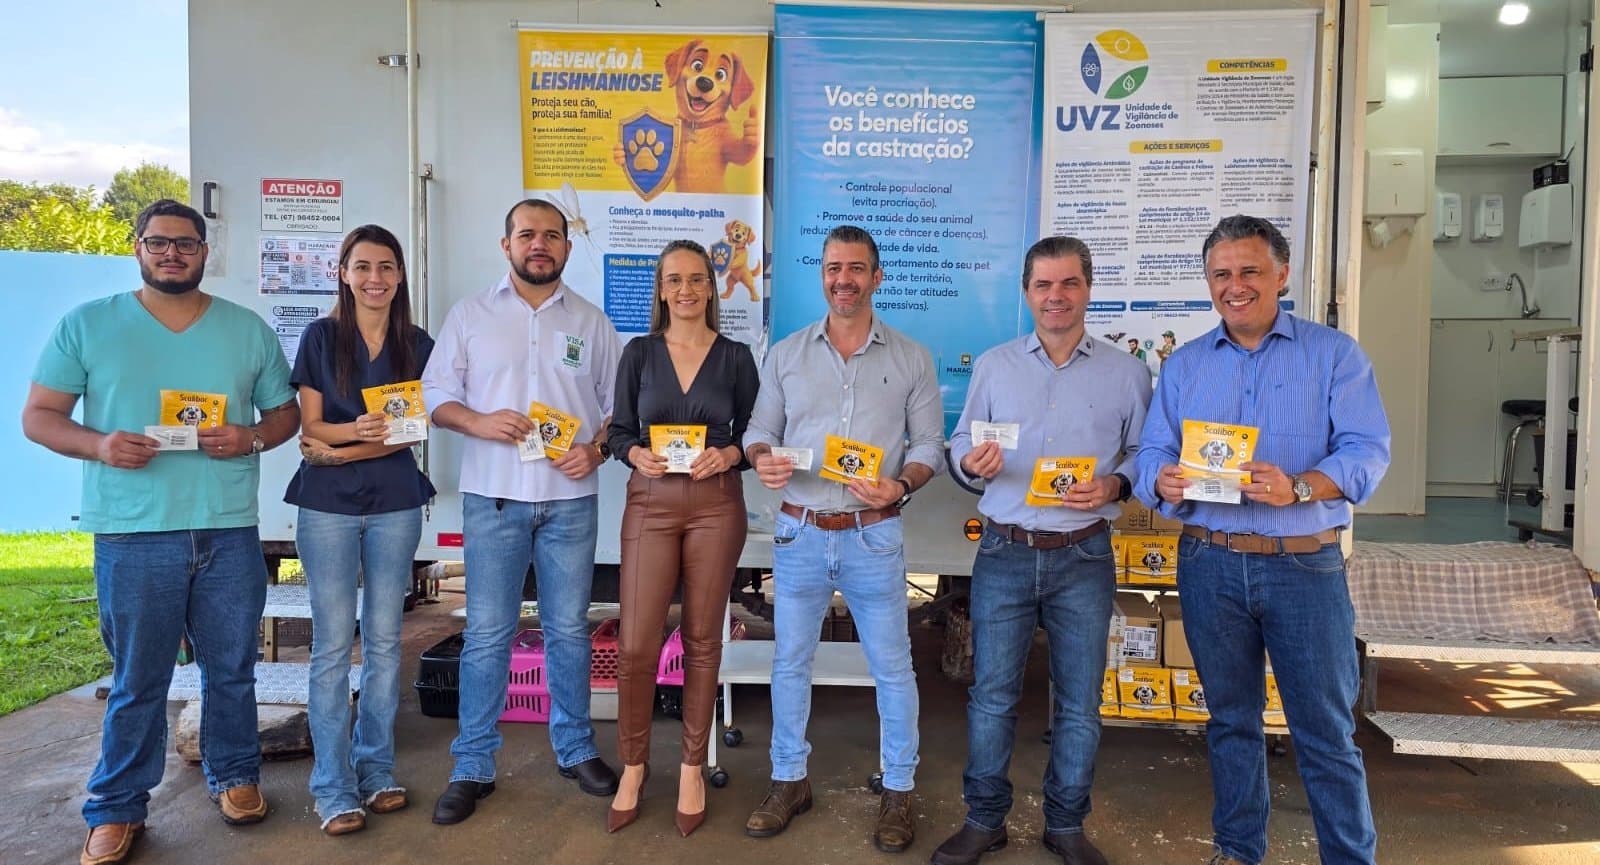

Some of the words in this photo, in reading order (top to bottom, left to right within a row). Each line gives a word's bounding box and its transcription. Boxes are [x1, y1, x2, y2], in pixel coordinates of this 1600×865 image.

[530, 47, 628, 72] PREVENÇÃO
[632, 47, 643, 69] À
[531, 72, 663, 92] LEISHMANIOSE
[532, 97, 561, 109] Proteja
[580, 97, 597, 108] cão,
[824, 84, 878, 108] Você
[882, 86, 976, 110] conhece
[532, 109, 560, 120] proteja
[580, 109, 612, 119] família!
[1056, 105, 1120, 132] UVZ
[1125, 103, 1160, 112] Unidade
[1125, 112, 1167, 122] Vigilância
[829, 116, 853, 132] os
[859, 110, 969, 134] benefícios
[822, 135, 850, 157] da
[856, 137, 974, 163] castração?
[1175, 142, 1210, 150] SERVIÇOS
[269, 183, 336, 196] ATENÇÃO
[846, 182, 887, 192] Controle
[889, 184, 952, 196] populacional
[852, 198, 877, 208] (evita
[880, 199, 937, 209] procriação).
[609, 206, 643, 218] Conheça
[653, 207, 725, 219] mosquito-palha
[822, 212, 864, 222] Promove
[875, 213, 904, 222] saúde
[906, 214, 919, 223] do
[939, 215, 973, 224] animal
[800, 225, 832, 236] (reduzi
[884, 228, 896, 236] de
[898, 229, 931, 238] câncer
[942, 229, 988, 239] doenças).
[902, 243, 914, 252] de
[916, 243, 940, 253] vida.
[941, 260, 954, 269] do
[974, 262, 991, 271] pet
[896, 272, 908, 282] de
[910, 273, 953, 284] território,
[883, 287, 902, 296] não
[904, 288, 917, 296] ter
[919, 288, 958, 297] atitudes
[875, 300, 929, 311] agressivas).
[566, 336, 584, 347] VISA
[1204, 425, 1236, 436] Scalibor
[841, 442, 867, 453] Scalibor
